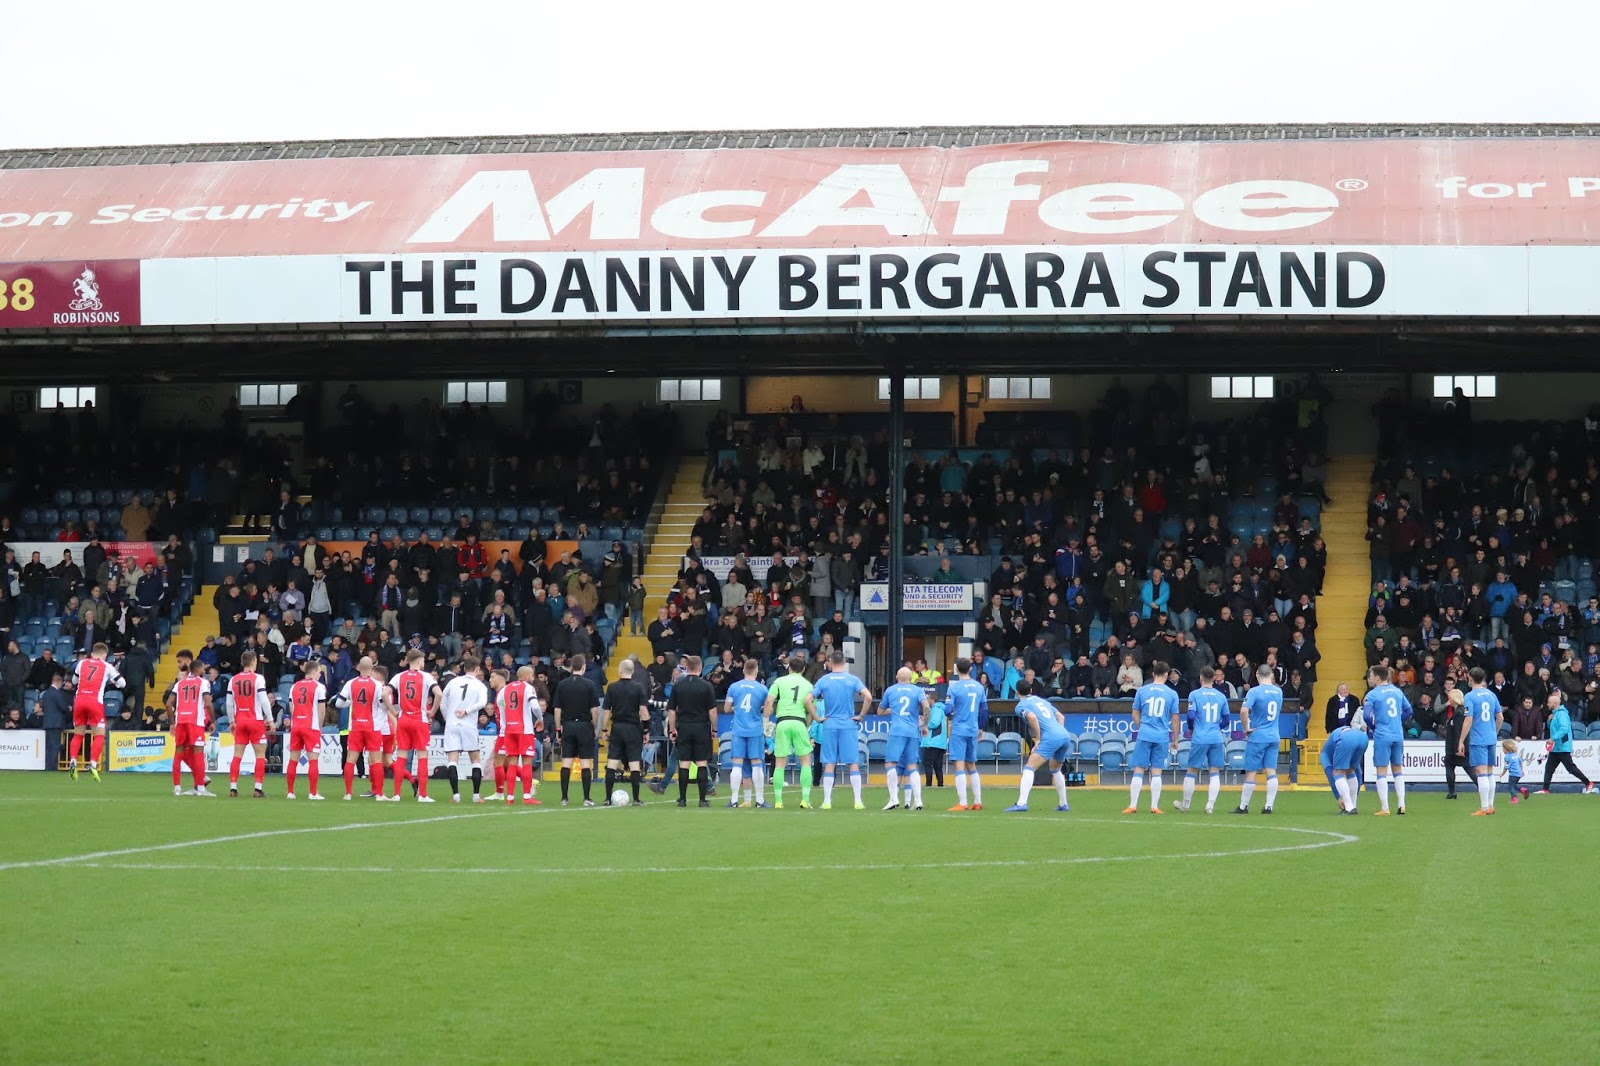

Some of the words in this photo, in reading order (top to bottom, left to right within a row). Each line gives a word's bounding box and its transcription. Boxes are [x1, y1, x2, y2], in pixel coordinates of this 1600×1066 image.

[1435, 176, 1546, 199] for
[405, 159, 1339, 243] McAfee
[90, 197, 374, 225] Security
[345, 259, 478, 315] THE
[500, 255, 757, 314] DANNY
[778, 251, 1121, 311] BERGARA
[1142, 250, 1386, 309] STAND
[53, 311, 120, 324] ROBINSONS
[88, 665, 98, 682] 7
[182, 684, 197, 702] 11
[235, 680, 252, 698] 10
[298, 687, 307, 705] 3
[356, 688, 367, 706] 4
[405, 681, 416, 700] 5
[460, 683, 469, 701] 1
[791, 685, 800, 704] 1
[509, 690, 519, 710] 9
[741, 693, 752, 712] 4
[899, 695, 911, 716] 2
[968, 692, 977, 712] 7
[1145, 696, 1166, 718] 10
[1386, 697, 1398, 718] 3
[1035, 702, 1051, 719] 5
[1202, 701, 1219, 723] 11
[1266, 700, 1278, 722] 9
[1481, 701, 1491, 722] 8
[136, 738, 164, 746] PROTEIN
